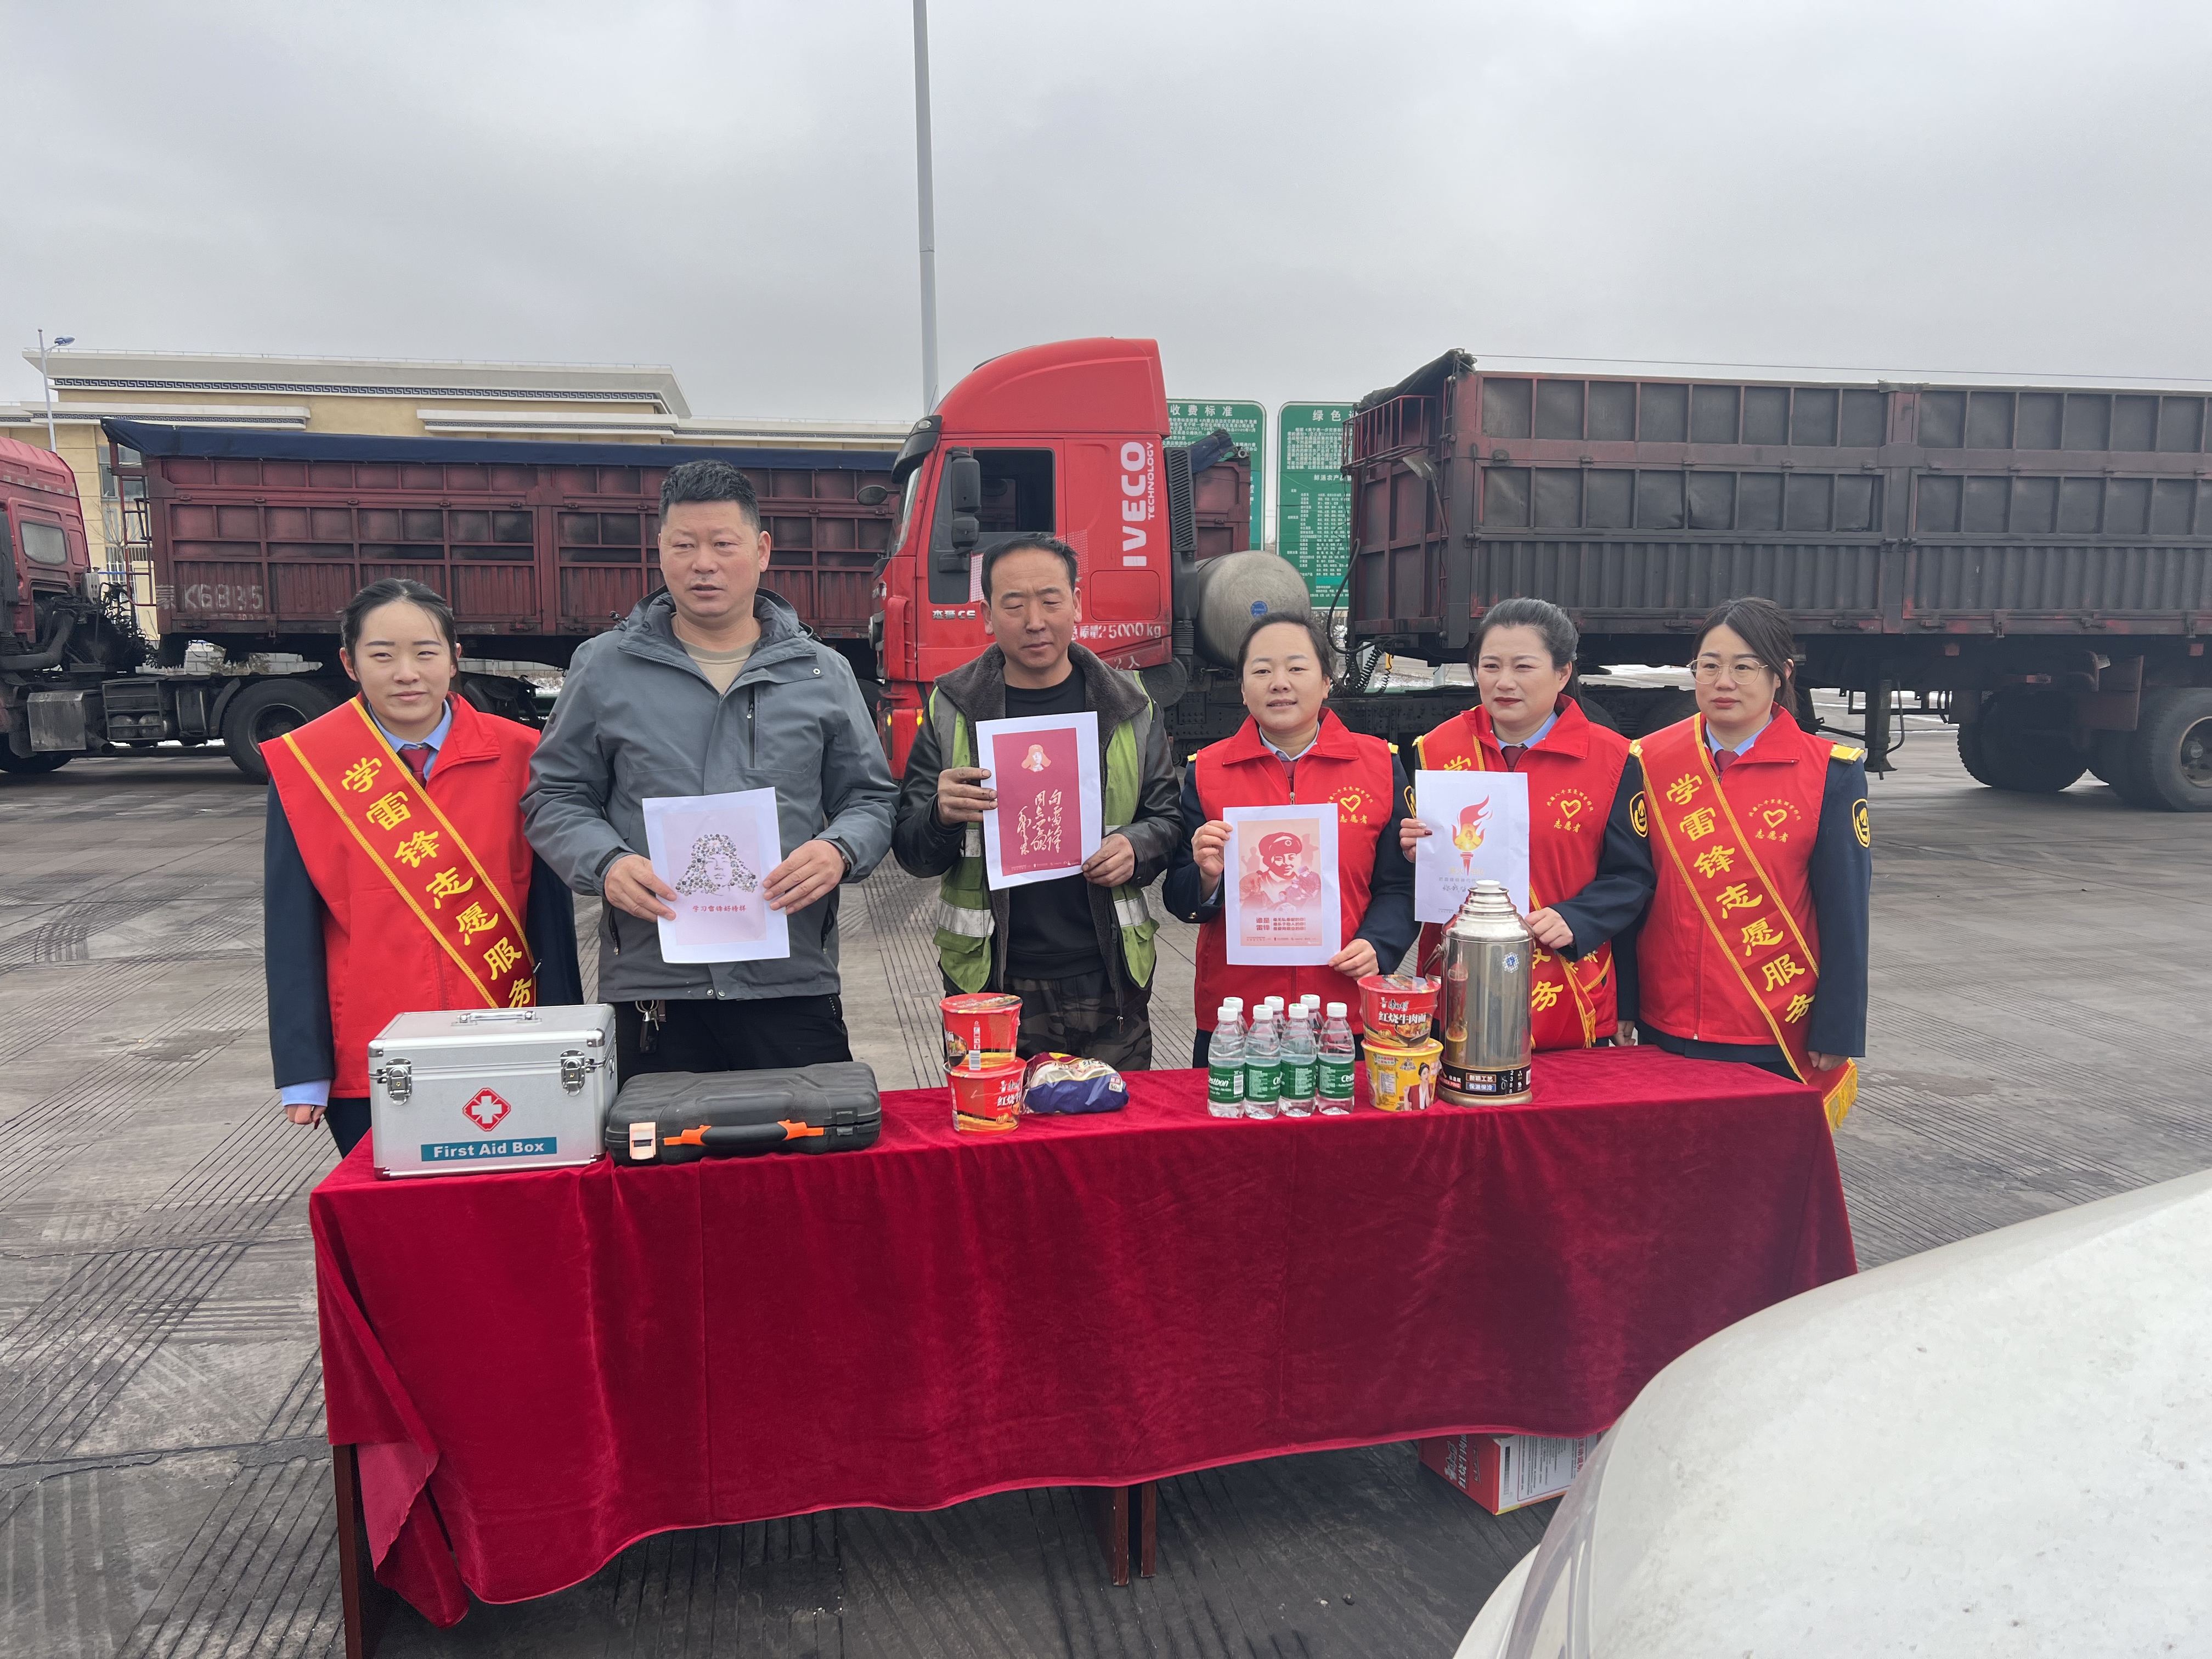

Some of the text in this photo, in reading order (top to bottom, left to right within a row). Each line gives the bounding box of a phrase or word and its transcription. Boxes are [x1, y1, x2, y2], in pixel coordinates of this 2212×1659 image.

[1170, 404, 1233, 416] 收费标准
[1147, 442, 1155, 521] TECHNOLOGY
[1121, 442, 1147, 567] IVECO
[1339, 813, 1368, 825] 志愿者
[1554, 817, 1582, 833] 志愿者
[1755, 828, 1789, 843] 志愿者
[341, 757, 533, 1008] 学雷锋志愿服务
[1666, 772, 1815, 1024] 学雷锋志愿服务
[692, 904, 747, 913] 学习雷锋好榜样
[1379, 1011, 1427, 1024] 红烧牛肉面
[433, 1141, 545, 1158] First Aid Box
